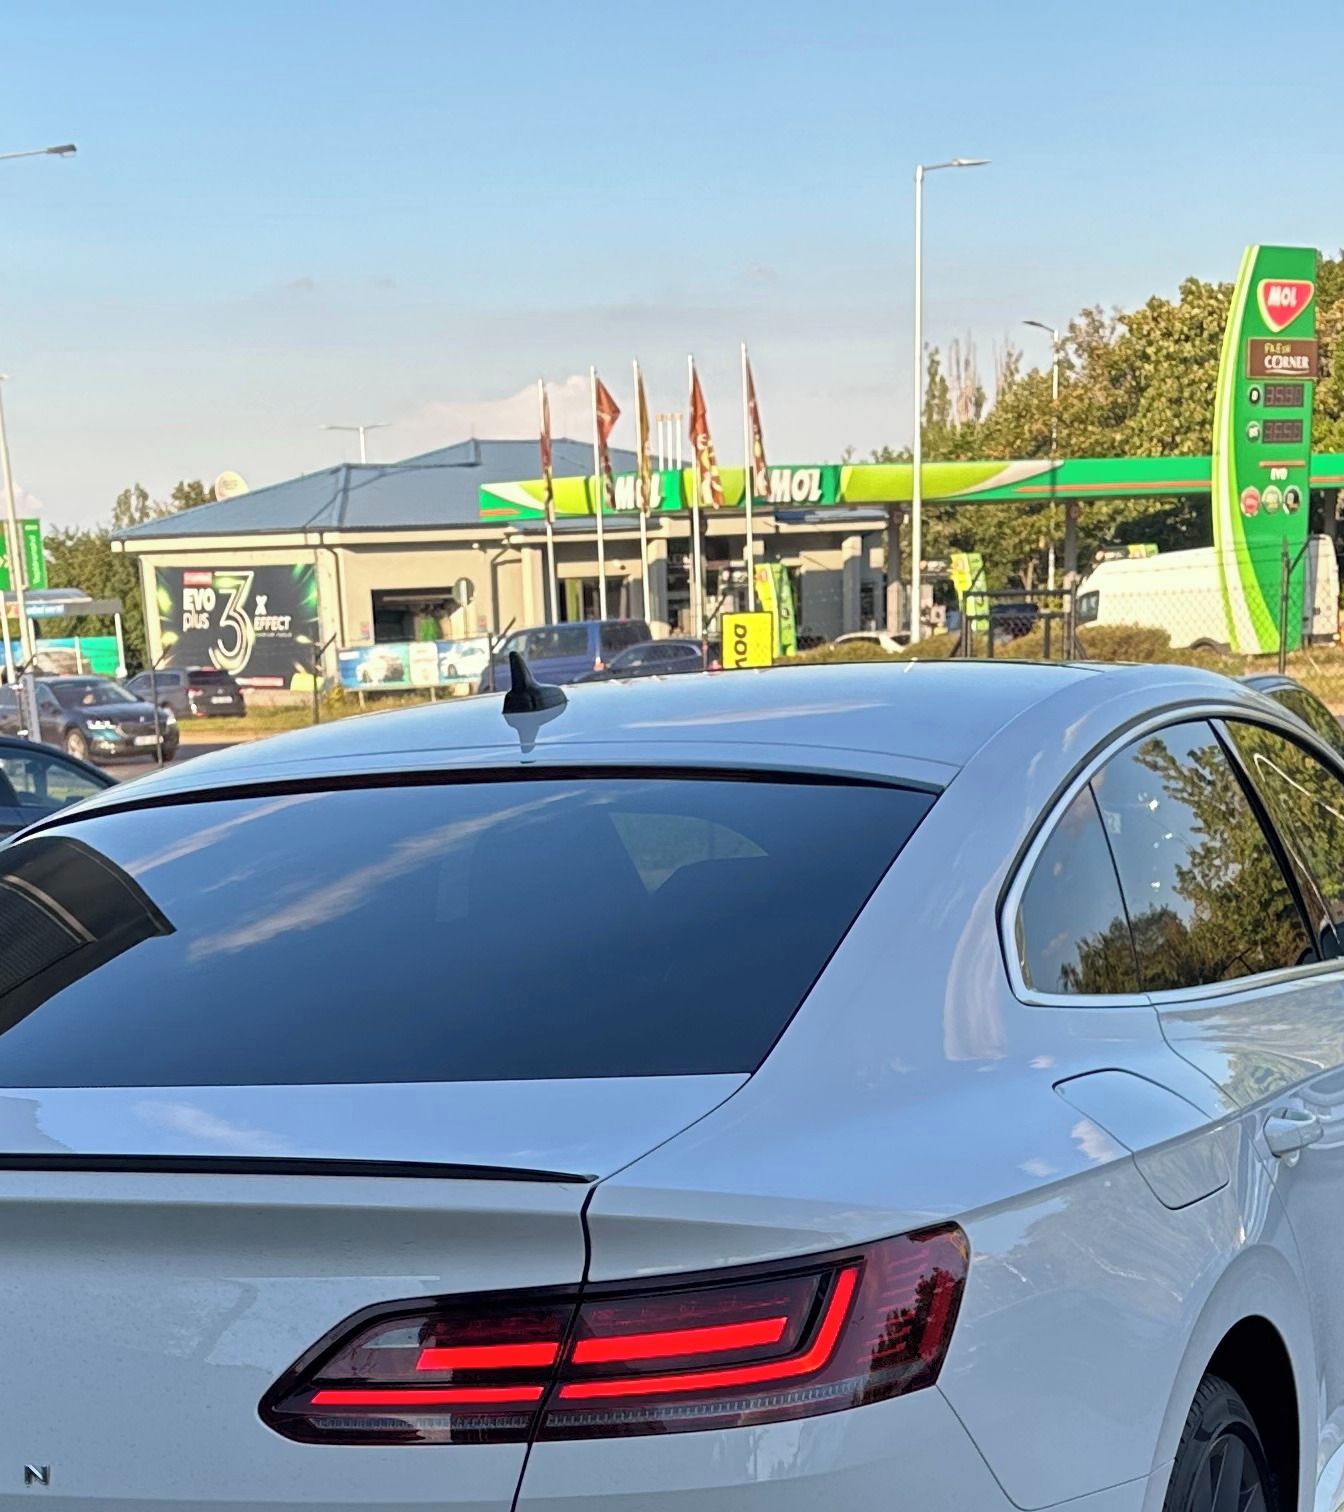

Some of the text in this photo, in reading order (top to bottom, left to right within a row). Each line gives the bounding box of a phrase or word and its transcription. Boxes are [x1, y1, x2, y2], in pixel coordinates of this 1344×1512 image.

[1267, 285, 1298, 307] MOL
[1264, 355, 1310, 369] CORNER
[767, 468, 823, 503] MOL
[182, 587, 216, 612] EVO
[182, 609, 210, 632] plus
[253, 615, 292, 631] EFFECT
